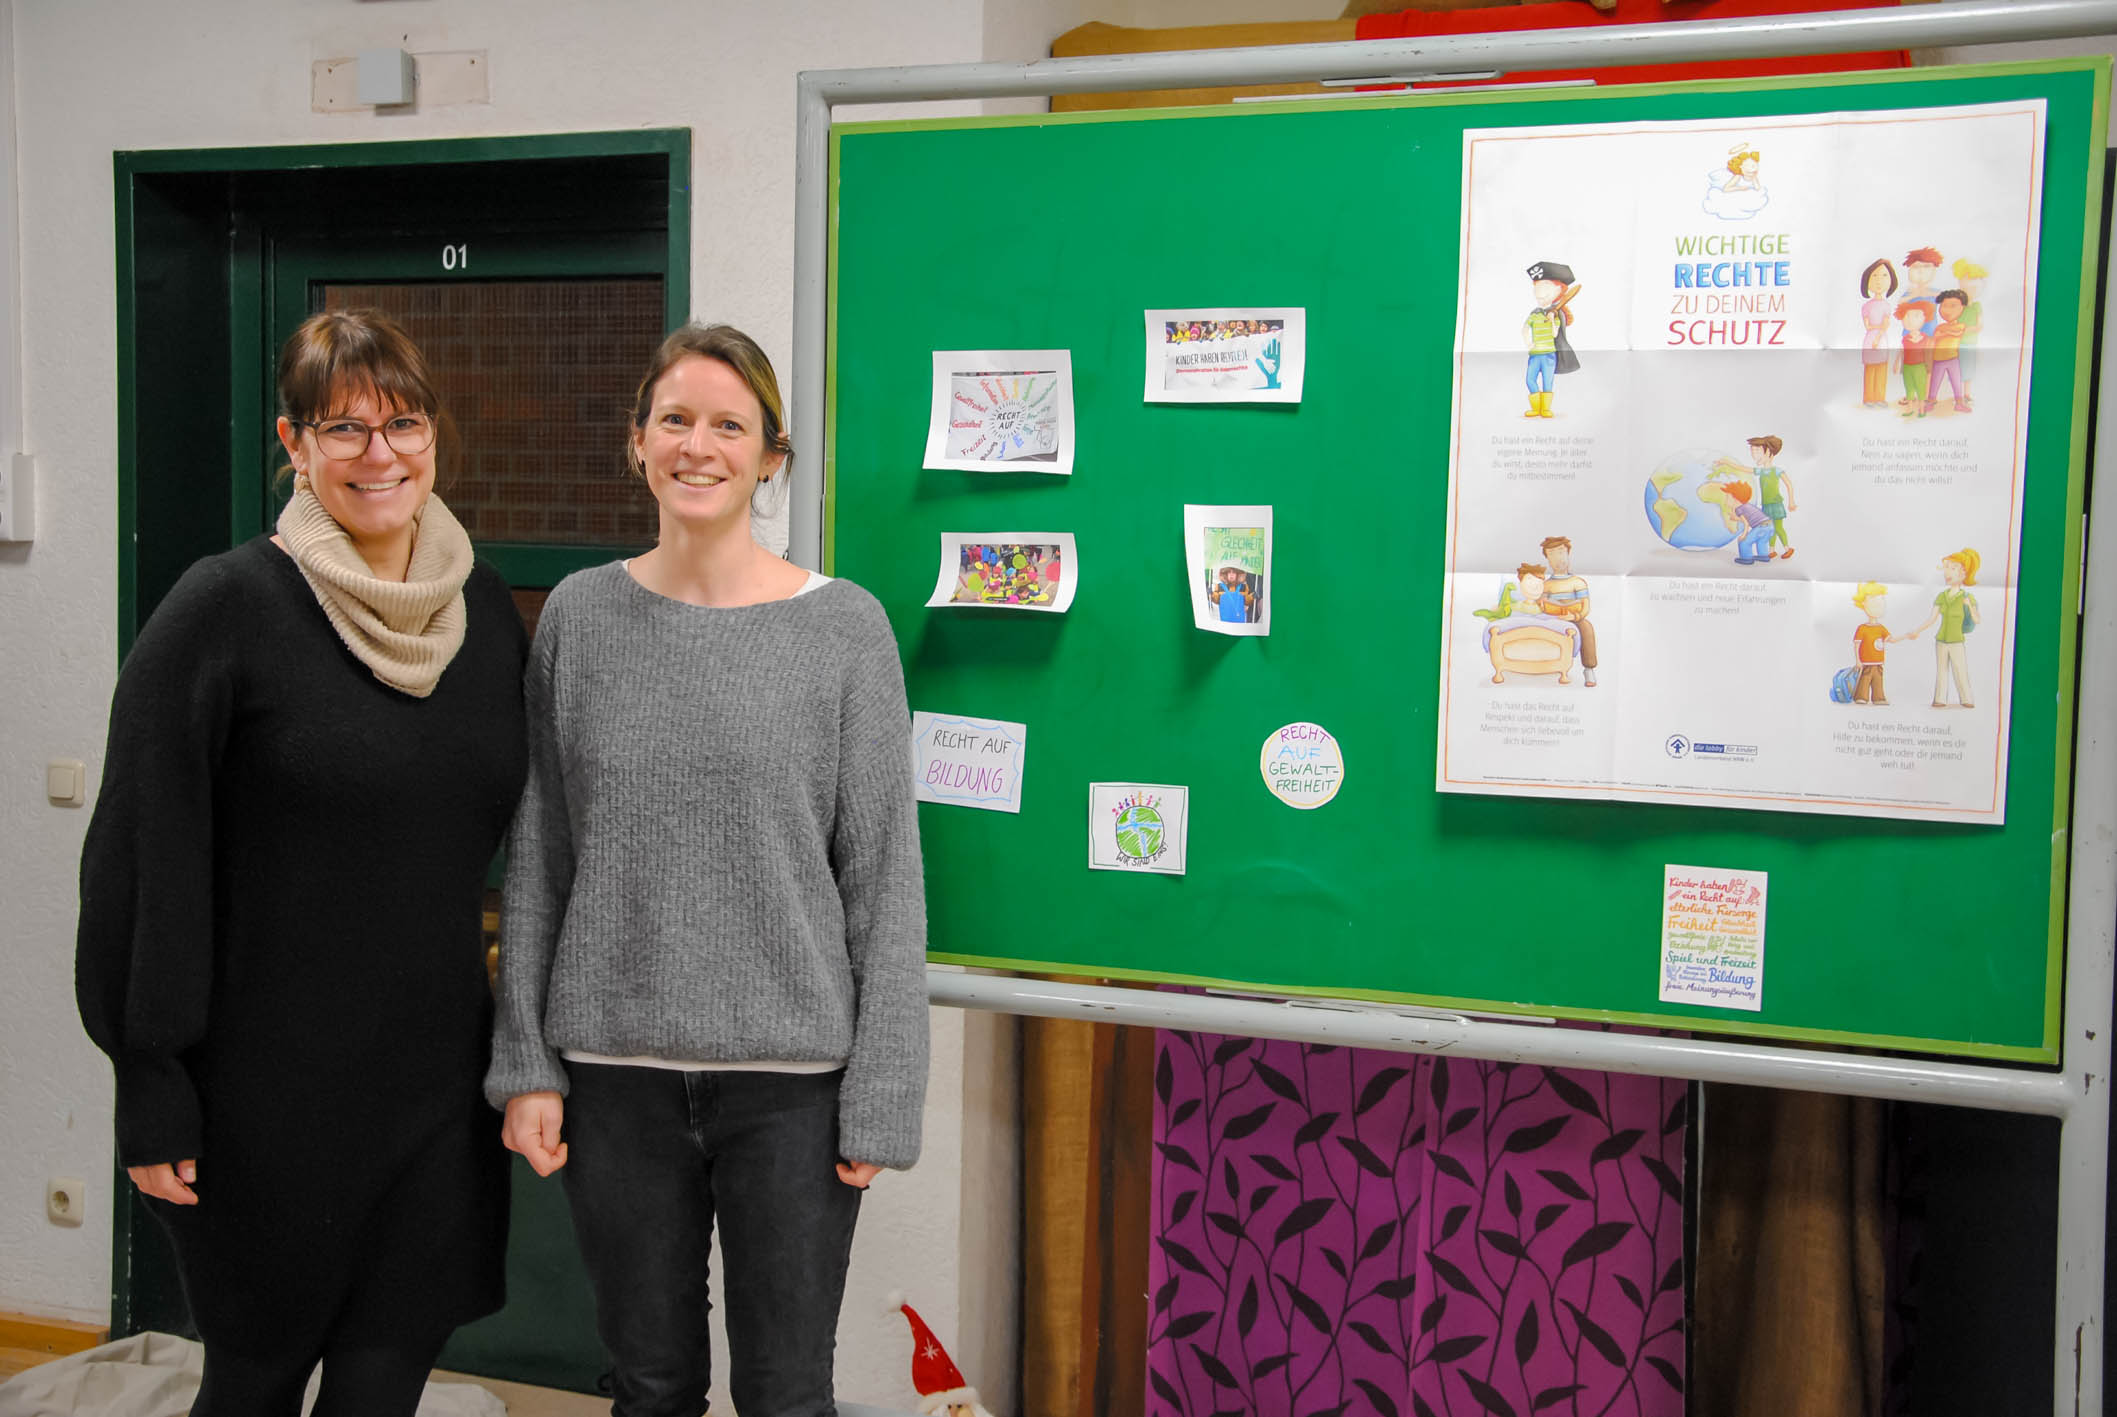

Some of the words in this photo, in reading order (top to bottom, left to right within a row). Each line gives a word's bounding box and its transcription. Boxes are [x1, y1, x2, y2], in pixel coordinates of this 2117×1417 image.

[1675, 234, 1791, 256] WICHTIGE
[442, 244, 467, 270] 01
[1674, 261, 1791, 288] RECHTE
[1671, 295, 1698, 314] ZU
[1706, 293, 1786, 314] DEINEM
[1667, 320, 1787, 345] SCHUTZ
[1176, 353, 1199, 365] KINDER
[1200, 351, 1219, 363] HABEN
[996, 411, 1020, 421] RECHT
[998, 420, 1015, 430] AUF
[1912, 438, 1936, 447] Recht
[1280, 725, 1331, 743] RECHT
[1862, 721, 1879, 731] hast
[1896, 723, 1920, 733] Recht
[932, 729, 979, 750] RECHT
[981, 737, 1012, 754] AUF
[1833, 732, 1851, 741] Hilfe
[1917, 738, 1941, 747] wenn
[1942, 740, 1953, 748] es
[1278, 744, 1321, 760] AUF
[1835, 745, 1855, 754] nicht
[1873, 747, 1893, 758] geht
[1895, 749, 1914, 758] oder
[1929, 750, 1963, 761] jemand
[1269, 762, 1339, 776] GEWALT-
[1880, 760, 1898, 769] weh
[926, 759, 1004, 794] BILDUNG
[1276, 779, 1335, 793] FREIHEIT
[1115, 851, 1129, 866] WIR
[1131, 857, 1150, 867] SIND
[1669, 877, 1698, 888] Kinder
[1699, 879, 1728, 893] haben
[1682, 890, 1697, 901] ein
[1699, 890, 1724, 903] Recht
[1725, 896, 1742, 908] auf
[1669, 902, 1713, 914] elterliche
[1716, 904, 1757, 921] Fürsorge
[1668, 914, 1718, 932] Freiheit
[1665, 950, 1693, 964] Spiel
[1696, 955, 1719, 966] und
[1720, 956, 1757, 968] Freizeit
[1708, 967, 1756, 990] Bildung
